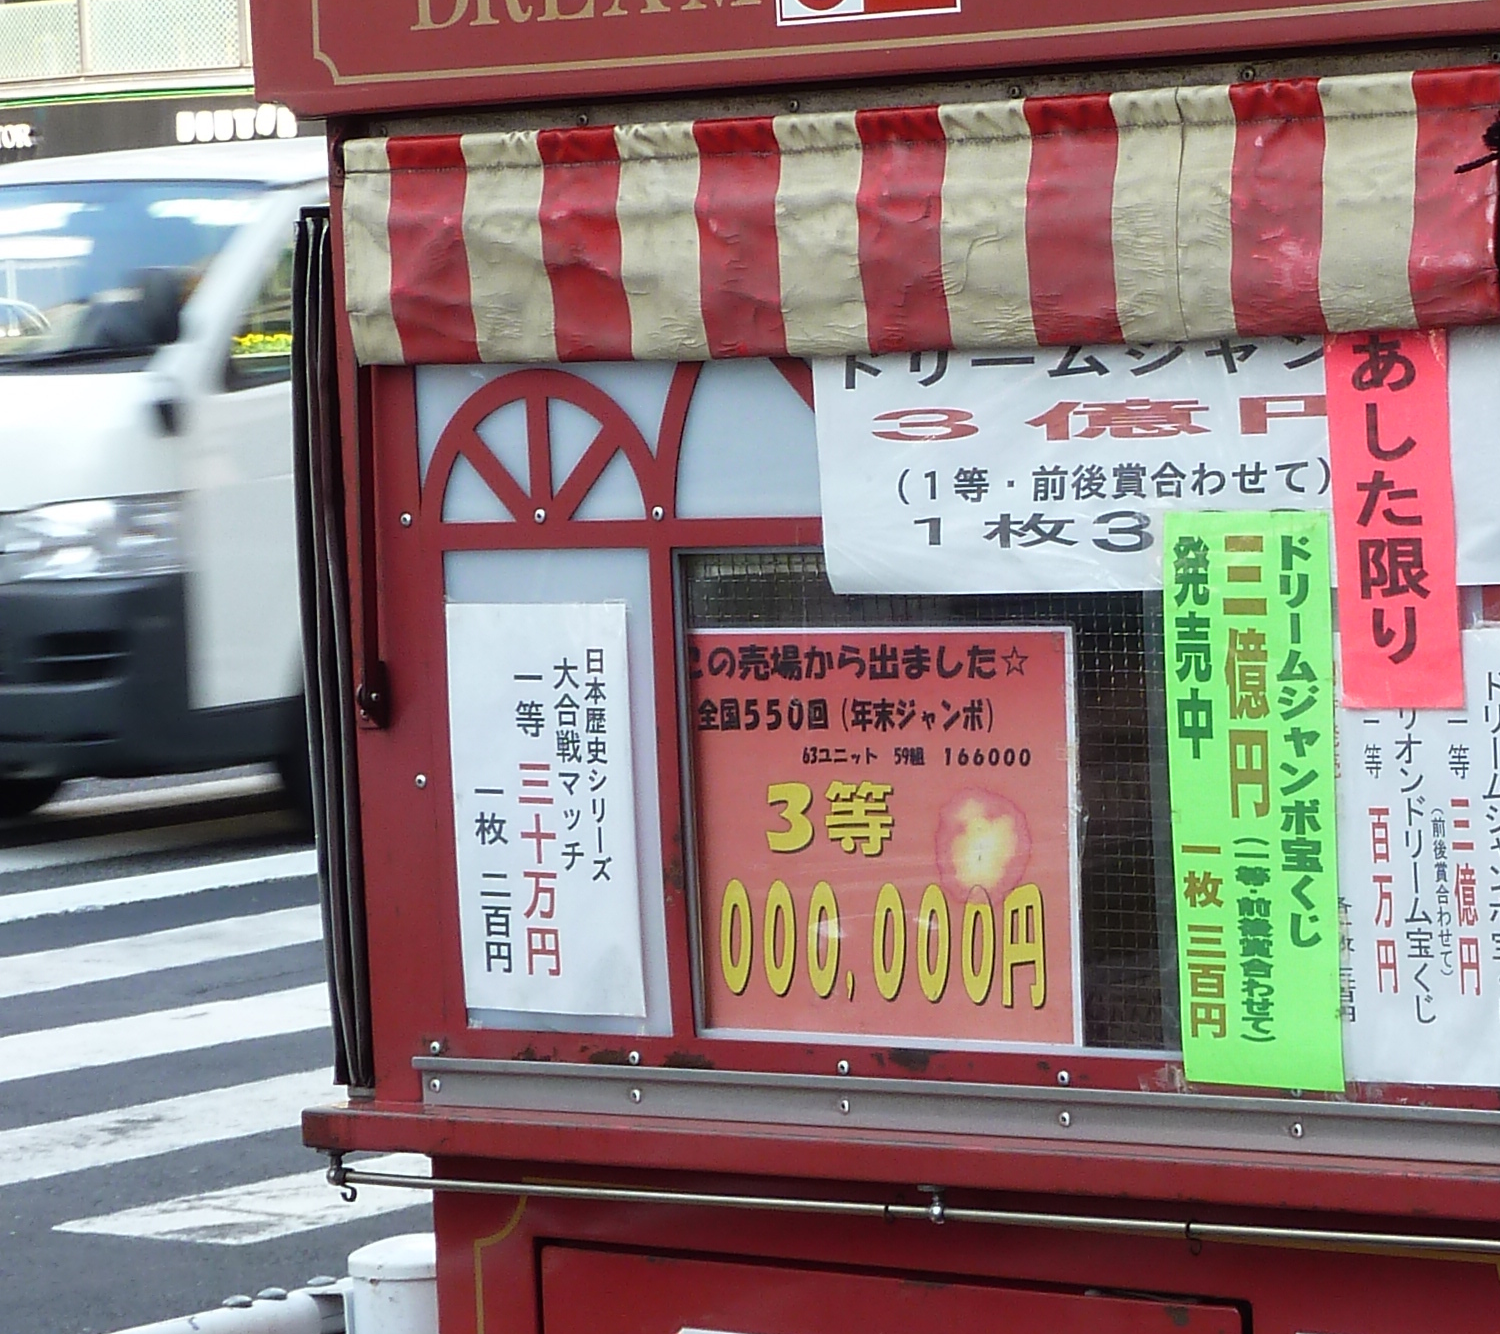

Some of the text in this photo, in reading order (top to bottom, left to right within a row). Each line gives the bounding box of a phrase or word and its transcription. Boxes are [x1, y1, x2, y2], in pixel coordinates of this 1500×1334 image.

[1351, 335, 1431, 665] あした限り
[552, 656, 585, 872] 大合戦マッチ
[584, 647, 612, 882] 日本歴史シリーズ
[698, 696, 996, 734] 全国550回 (年末ジャンボ)
[943, 745, 1032, 768] 166000
[1172, 535, 1228, 1039] 発売中 一枚 三百円
[1223, 535, 1272, 819] 三億円
[1276, 535, 1324, 949] ドリームジャンボ宝くじ
[473, 786, 514, 974] 一枚 二百円
[513, 673, 563, 978] 一等 三十万円
[765, 779, 895, 856] 3等
[1363, 718, 1400, 995] 一等 百万円
[1394, 708, 1438, 1025] リオンドリーム宝くじ
[1447, 718, 1482, 996] 一等 三億円
